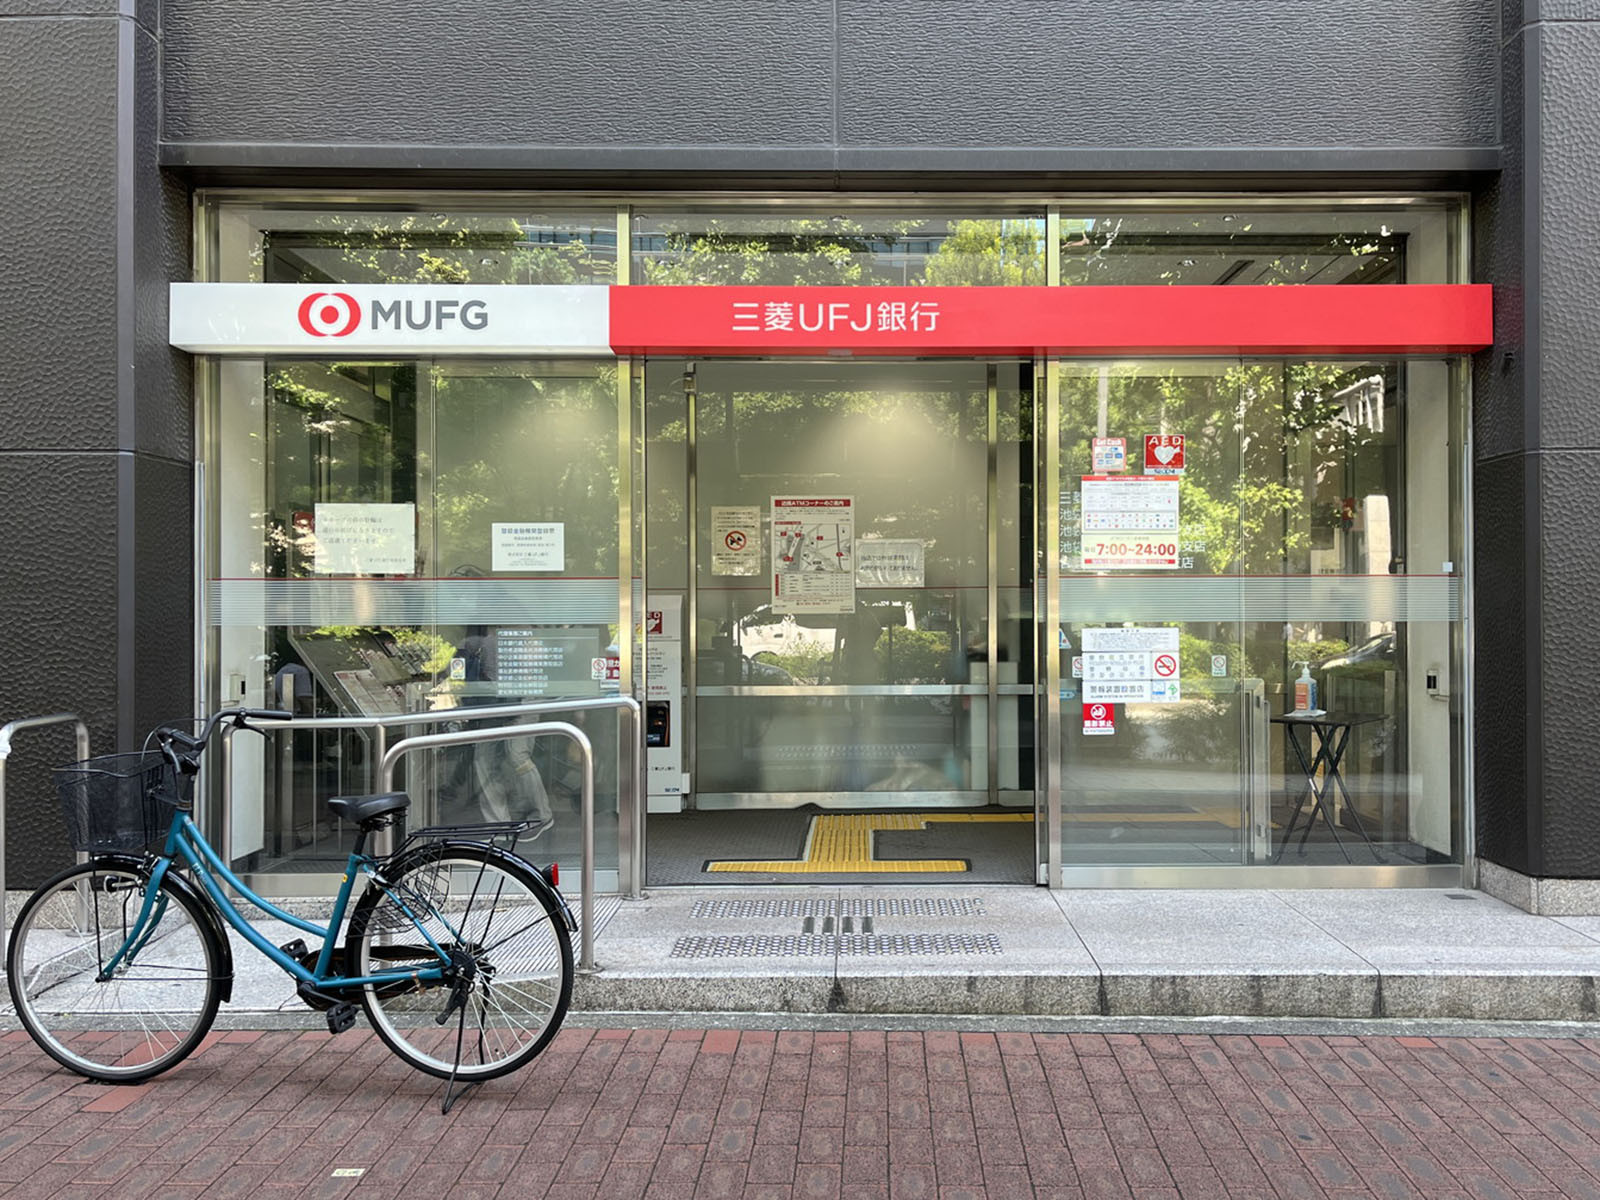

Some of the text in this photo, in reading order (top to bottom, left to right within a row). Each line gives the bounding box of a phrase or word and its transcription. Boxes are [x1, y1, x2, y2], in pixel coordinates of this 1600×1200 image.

[371, 300, 488, 330] MUFG
[732, 302, 940, 332] 三菱UFJ銀行
[1148, 436, 1182, 446] AED
